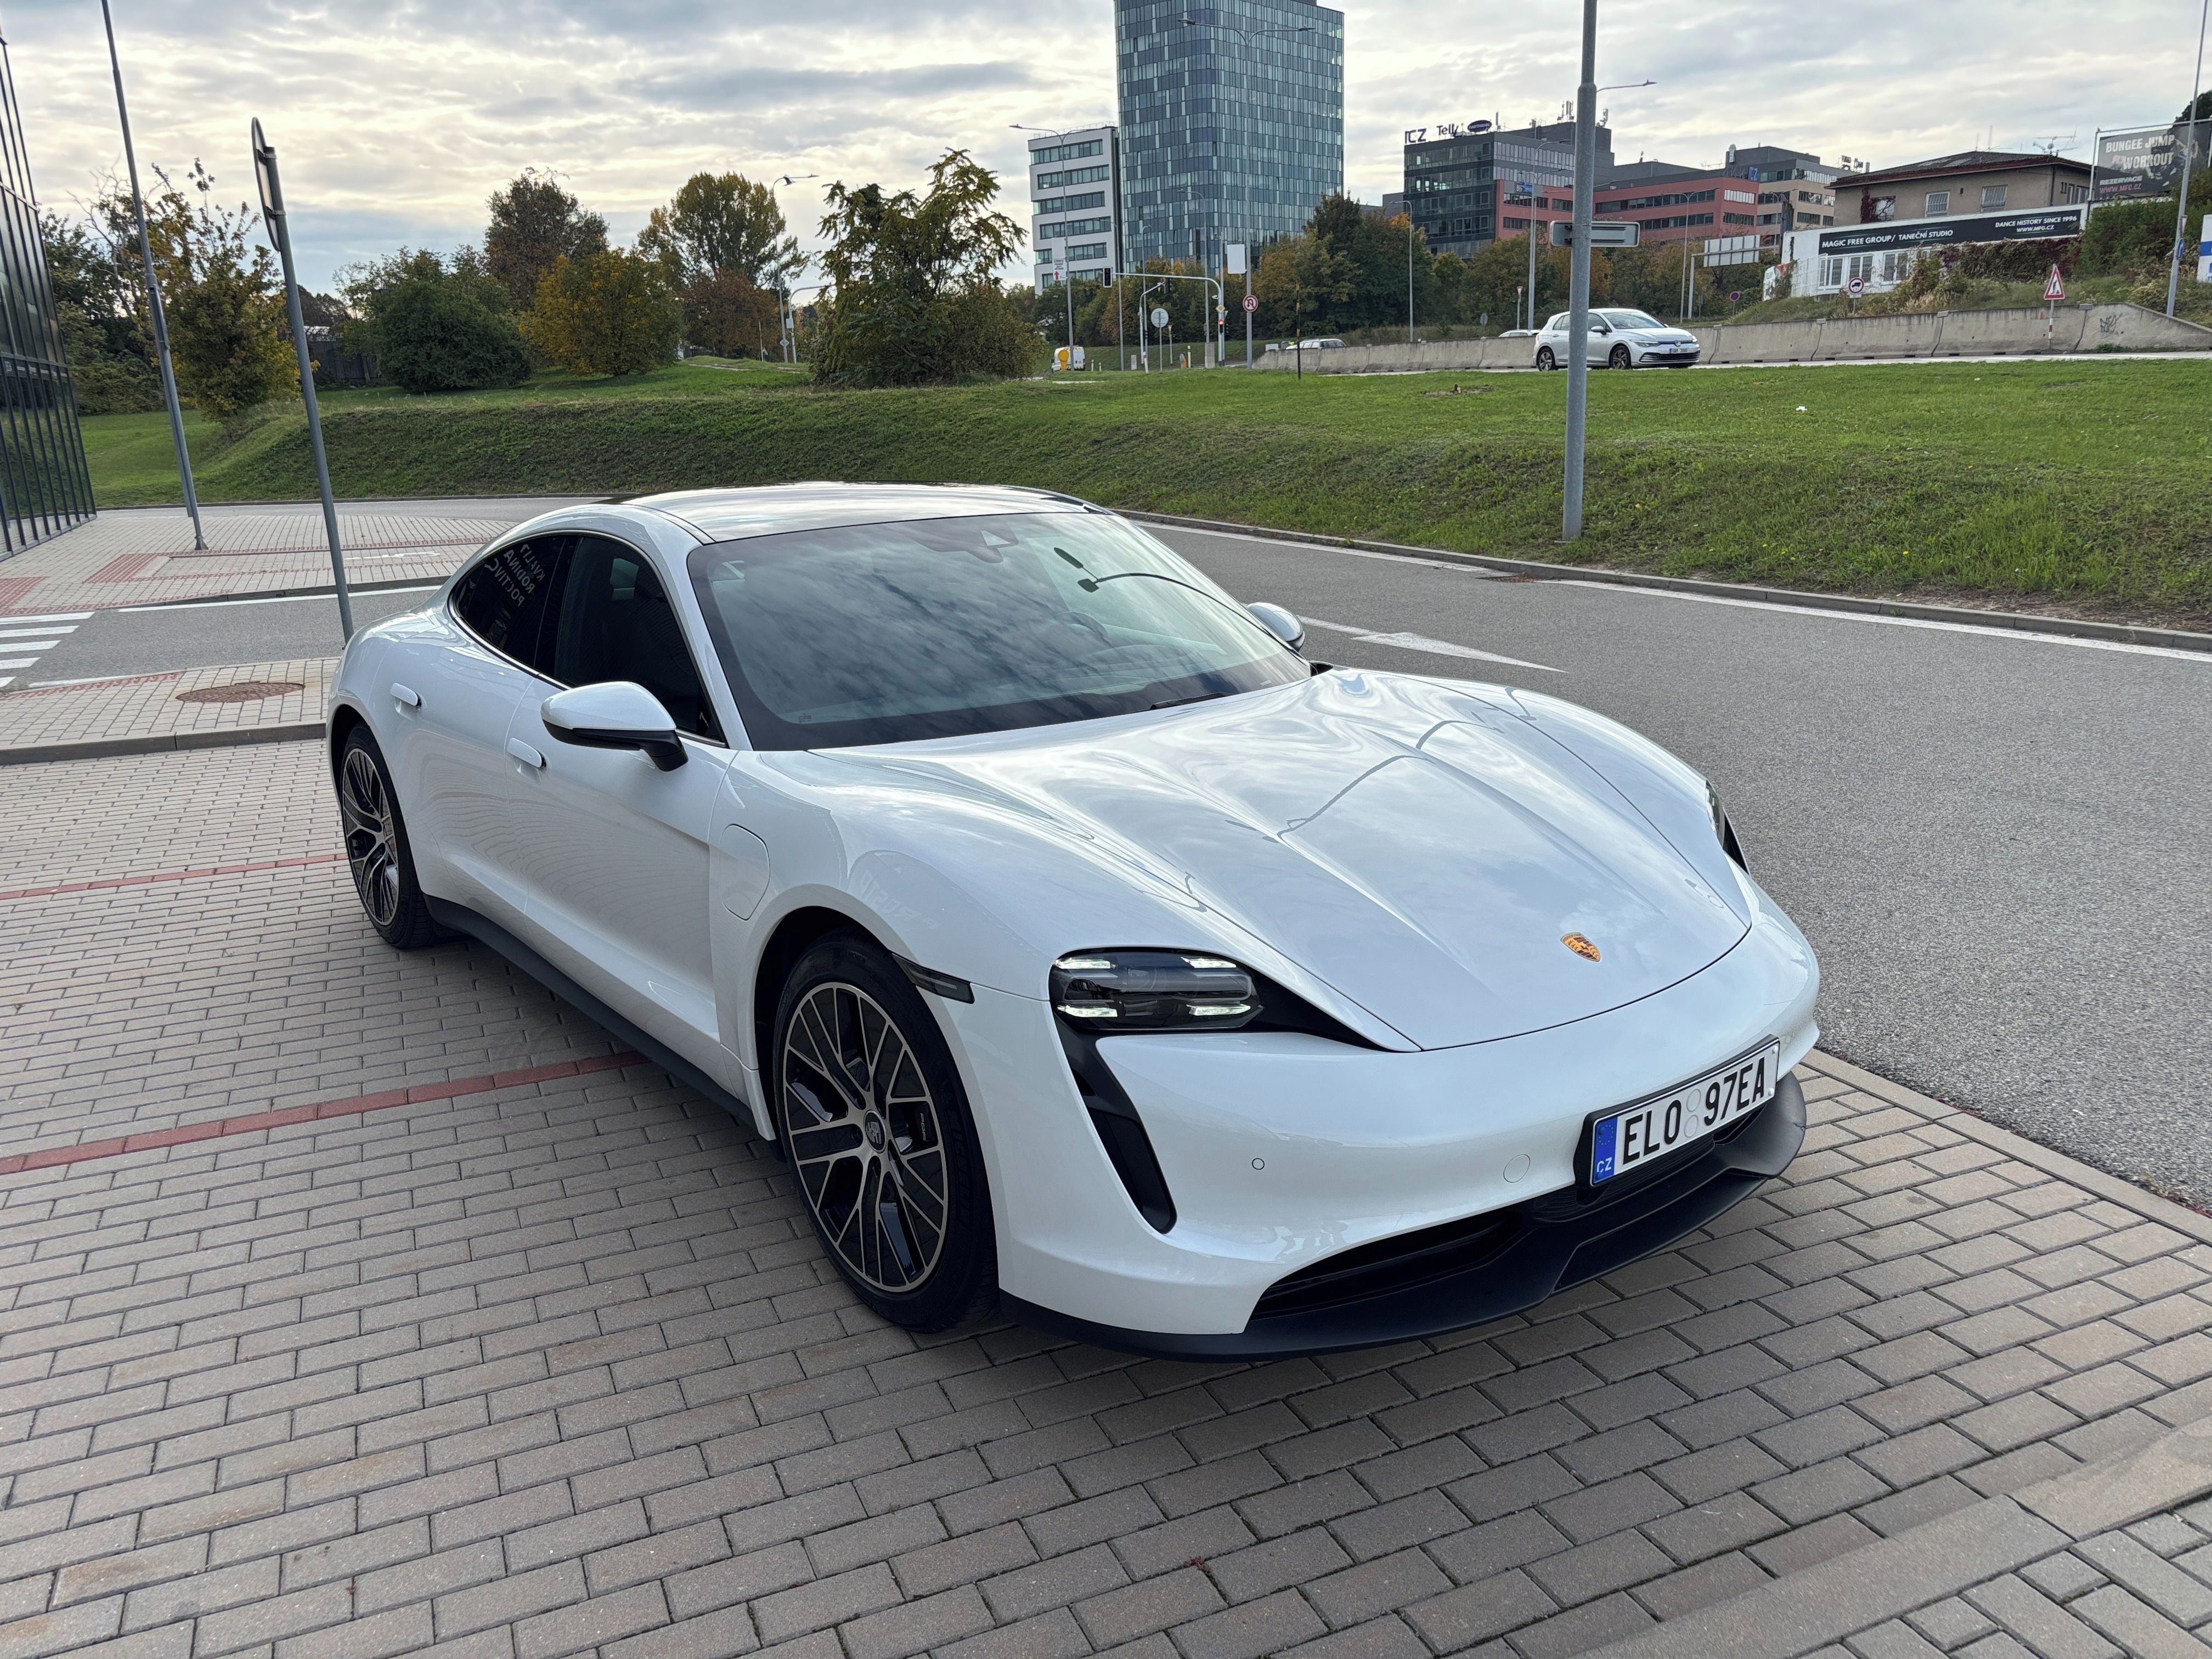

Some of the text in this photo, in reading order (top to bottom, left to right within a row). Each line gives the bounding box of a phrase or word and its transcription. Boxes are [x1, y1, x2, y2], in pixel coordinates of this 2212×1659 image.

[1404, 128, 1426, 144] ICZ
[1436, 123, 1459, 137] Telly
[2106, 134, 2175, 153] BUNGEE JUMP
[2124, 153, 2174, 170] WORKOUT
[2100, 176, 2142, 185] REZERVACE
[2100, 184, 2141, 194] WWW.MFG.CZ
[1822, 239, 1846, 248] MAGIC
[1847, 238, 1864, 246] FREE
[1898, 231, 1928, 241] TANEČNÍ
[1928, 229, 1953, 238] STUDIO
[1703, 1056, 1765, 1126] 97EA
[1596, 1156, 1612, 1173] CZ
